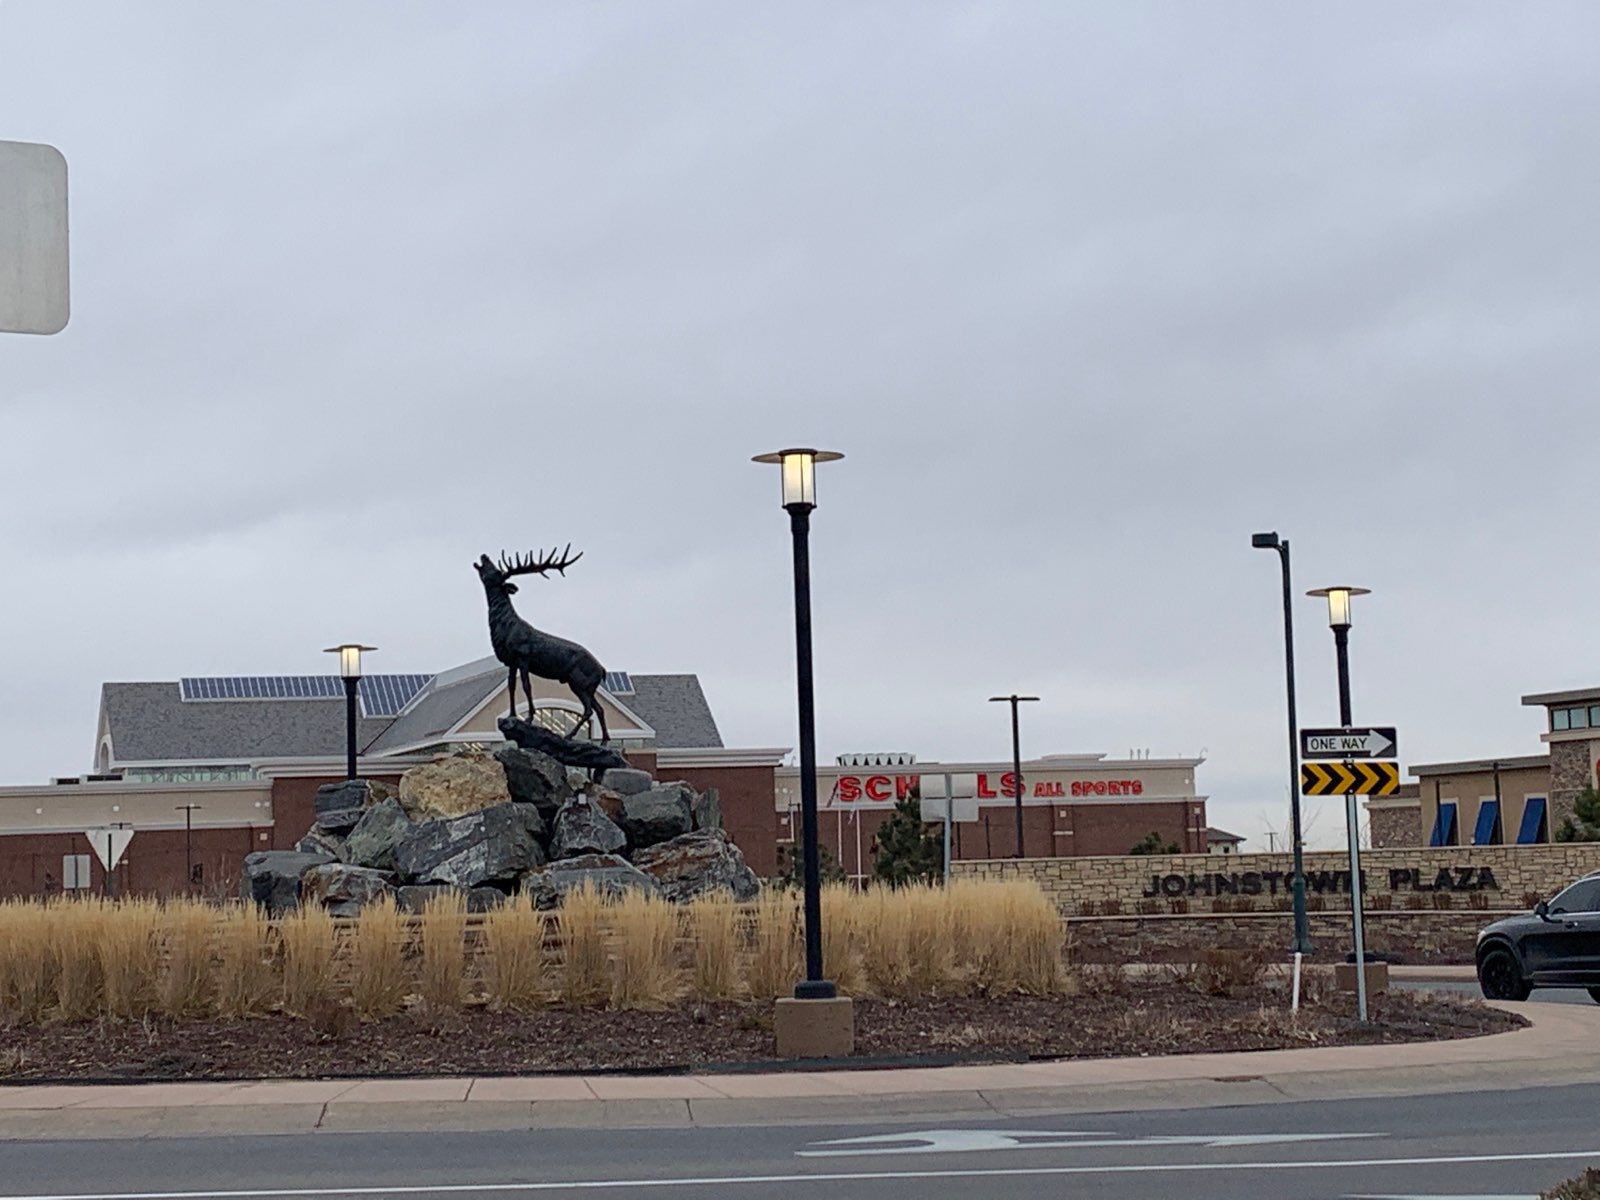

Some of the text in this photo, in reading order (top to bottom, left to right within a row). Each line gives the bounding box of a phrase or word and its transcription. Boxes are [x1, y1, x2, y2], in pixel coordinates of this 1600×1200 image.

[1310, 737, 1367, 750] ONE WAY
[838, 771, 1144, 801] SCHLS ALL SPORTS
[1389, 867, 1498, 891] PLAZA
